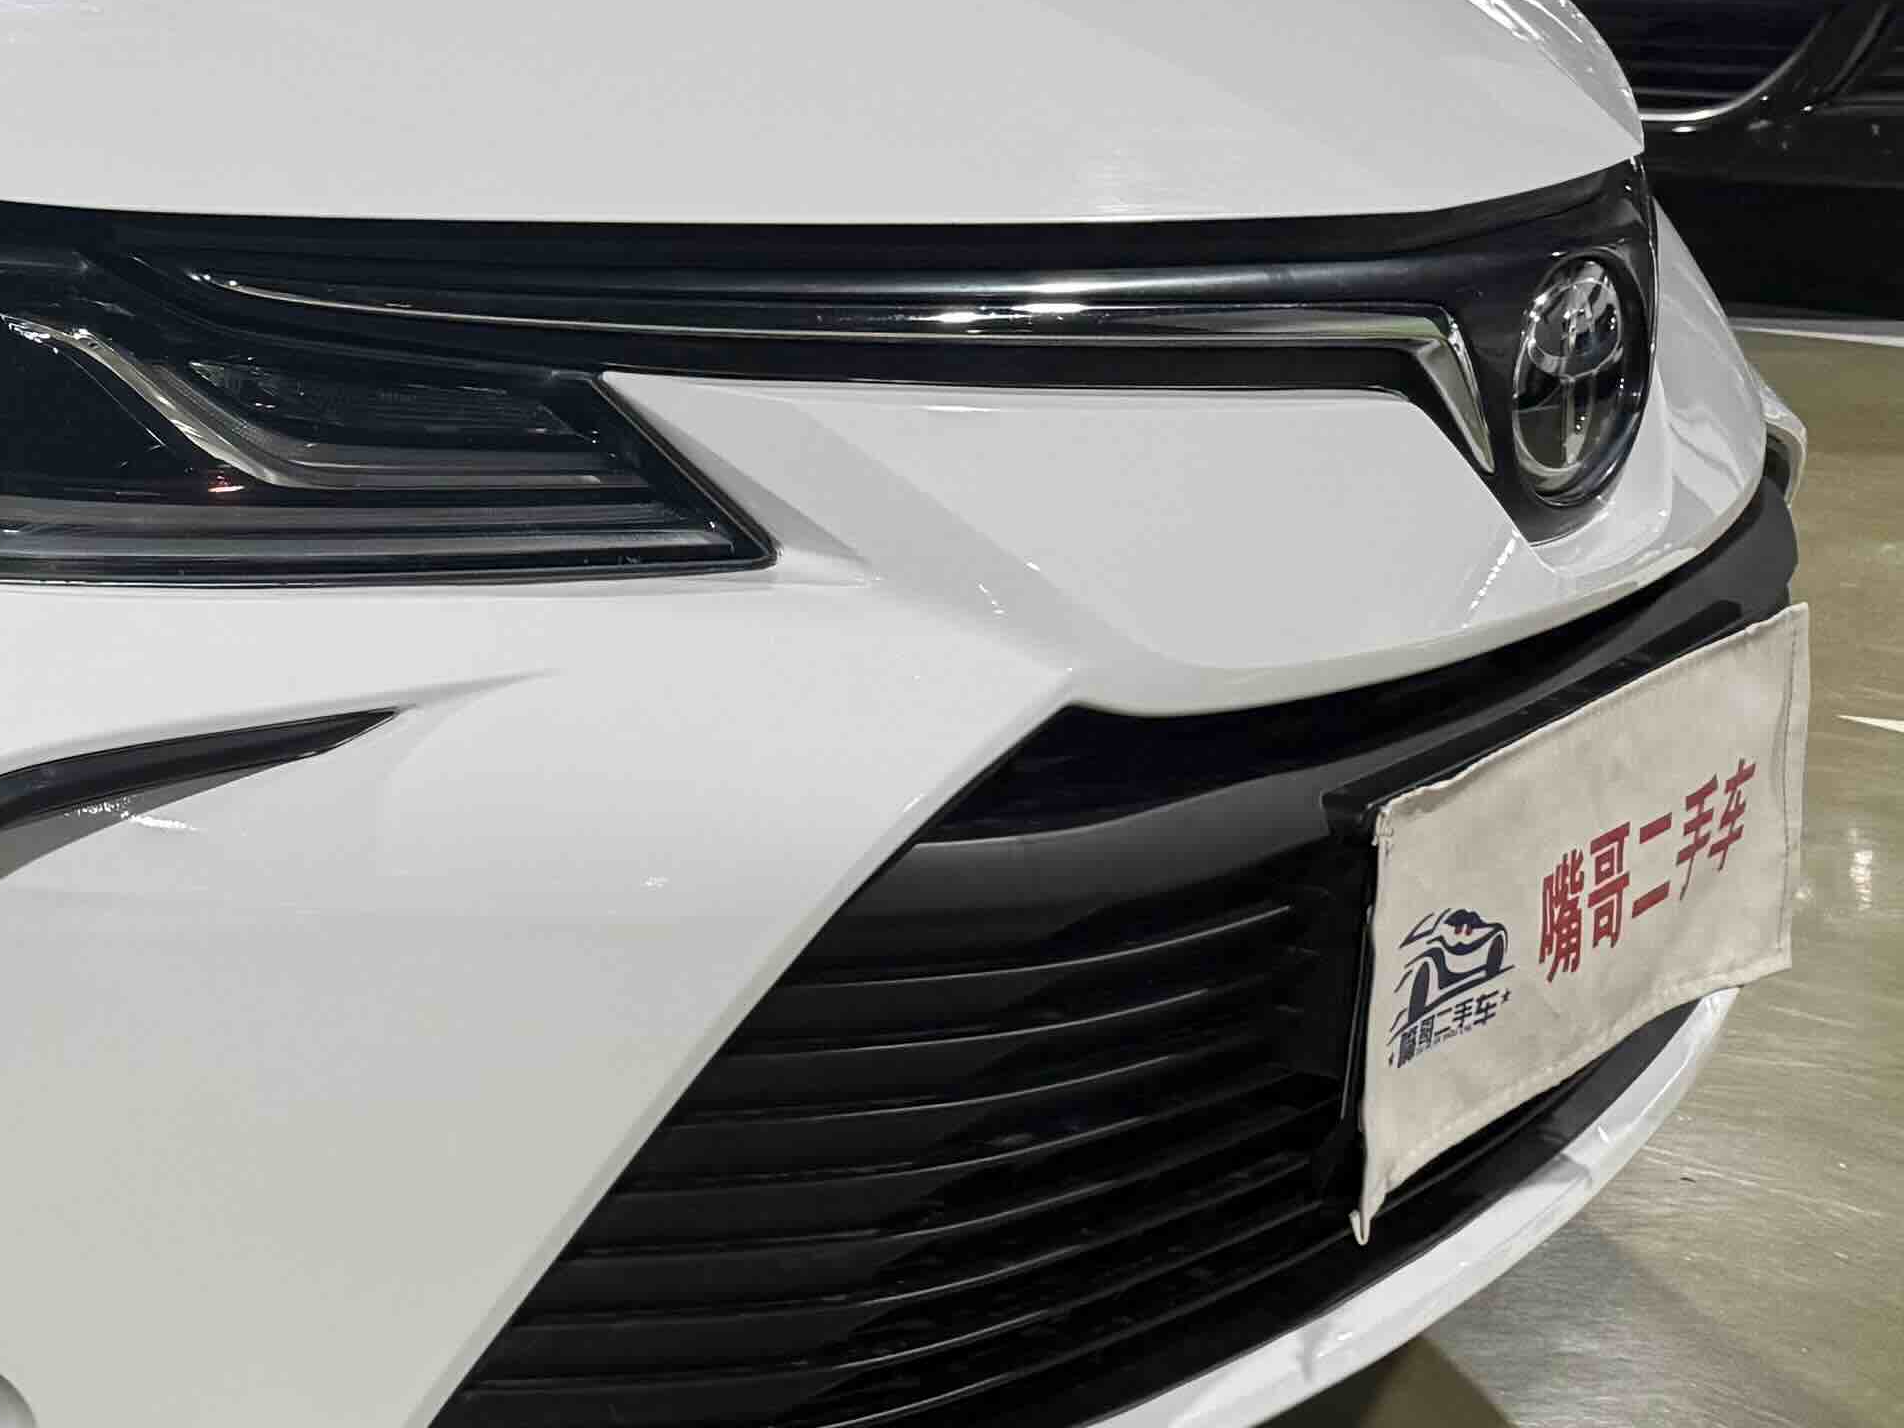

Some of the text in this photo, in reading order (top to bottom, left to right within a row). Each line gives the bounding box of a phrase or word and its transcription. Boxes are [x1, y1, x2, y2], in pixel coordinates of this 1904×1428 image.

[1539, 758, 1757, 982] 嘴哥二手车
